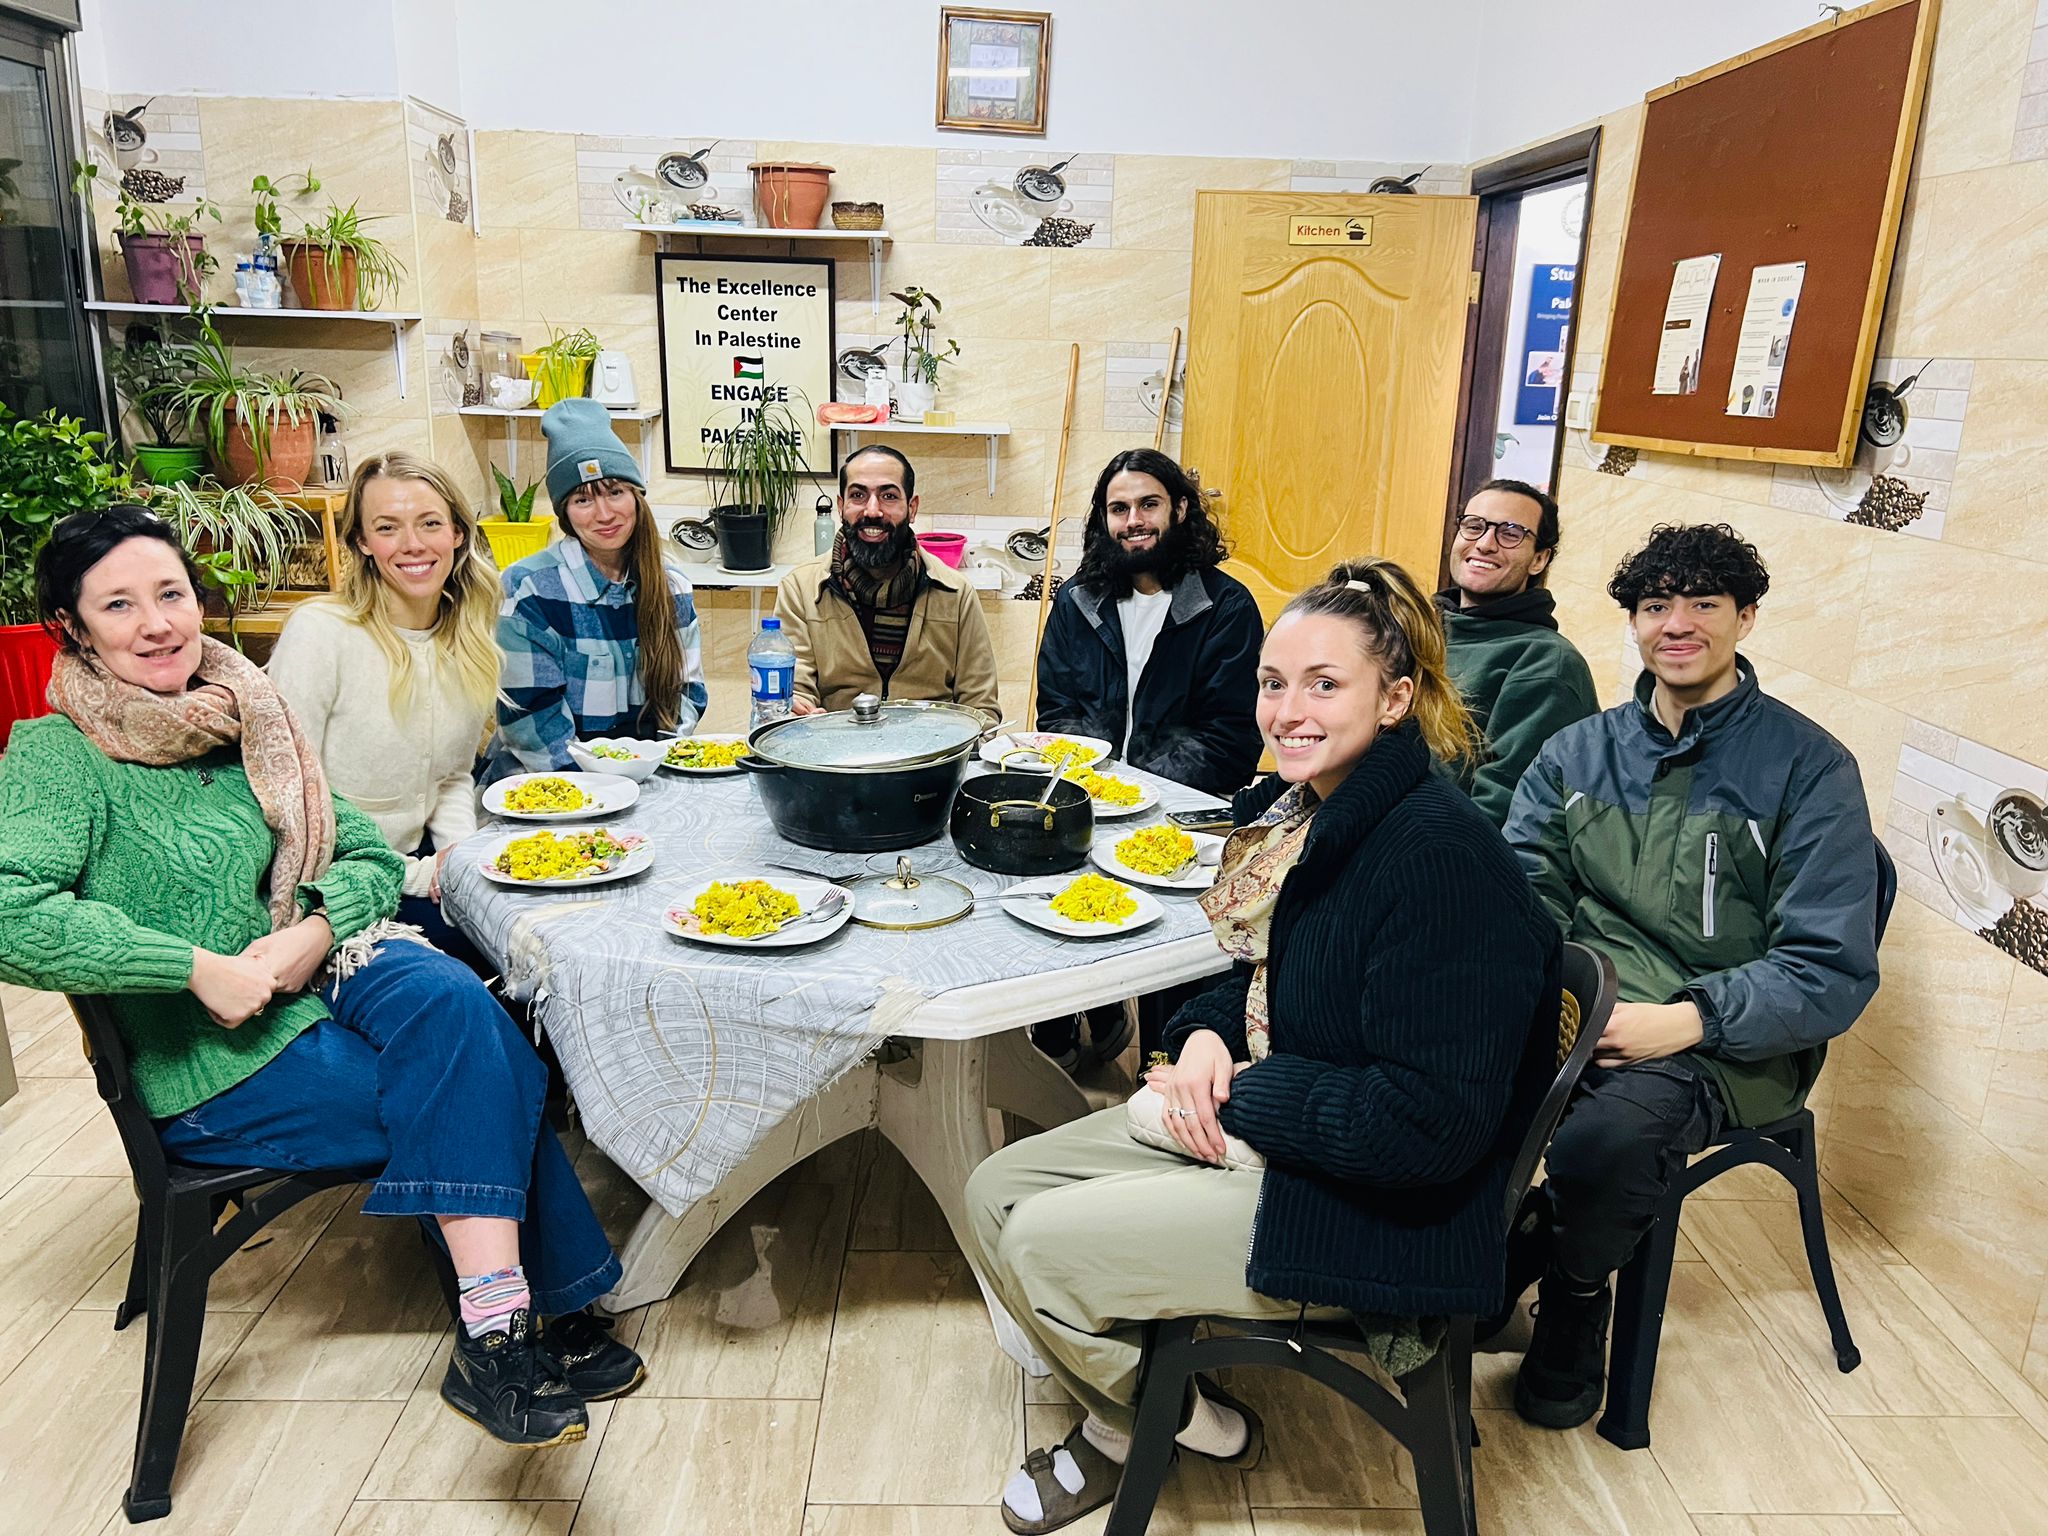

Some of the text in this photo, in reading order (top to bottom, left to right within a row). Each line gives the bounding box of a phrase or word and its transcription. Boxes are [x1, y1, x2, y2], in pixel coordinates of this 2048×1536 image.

[1296, 225, 1341, 236] Kitchen
[676, 276, 817, 297] The Excellence
[717, 304, 778, 322] Center
[695, 329, 801, 349] In Palestine
[711, 384, 789, 403] ENGAGE
[741, 407, 762, 423] IN
